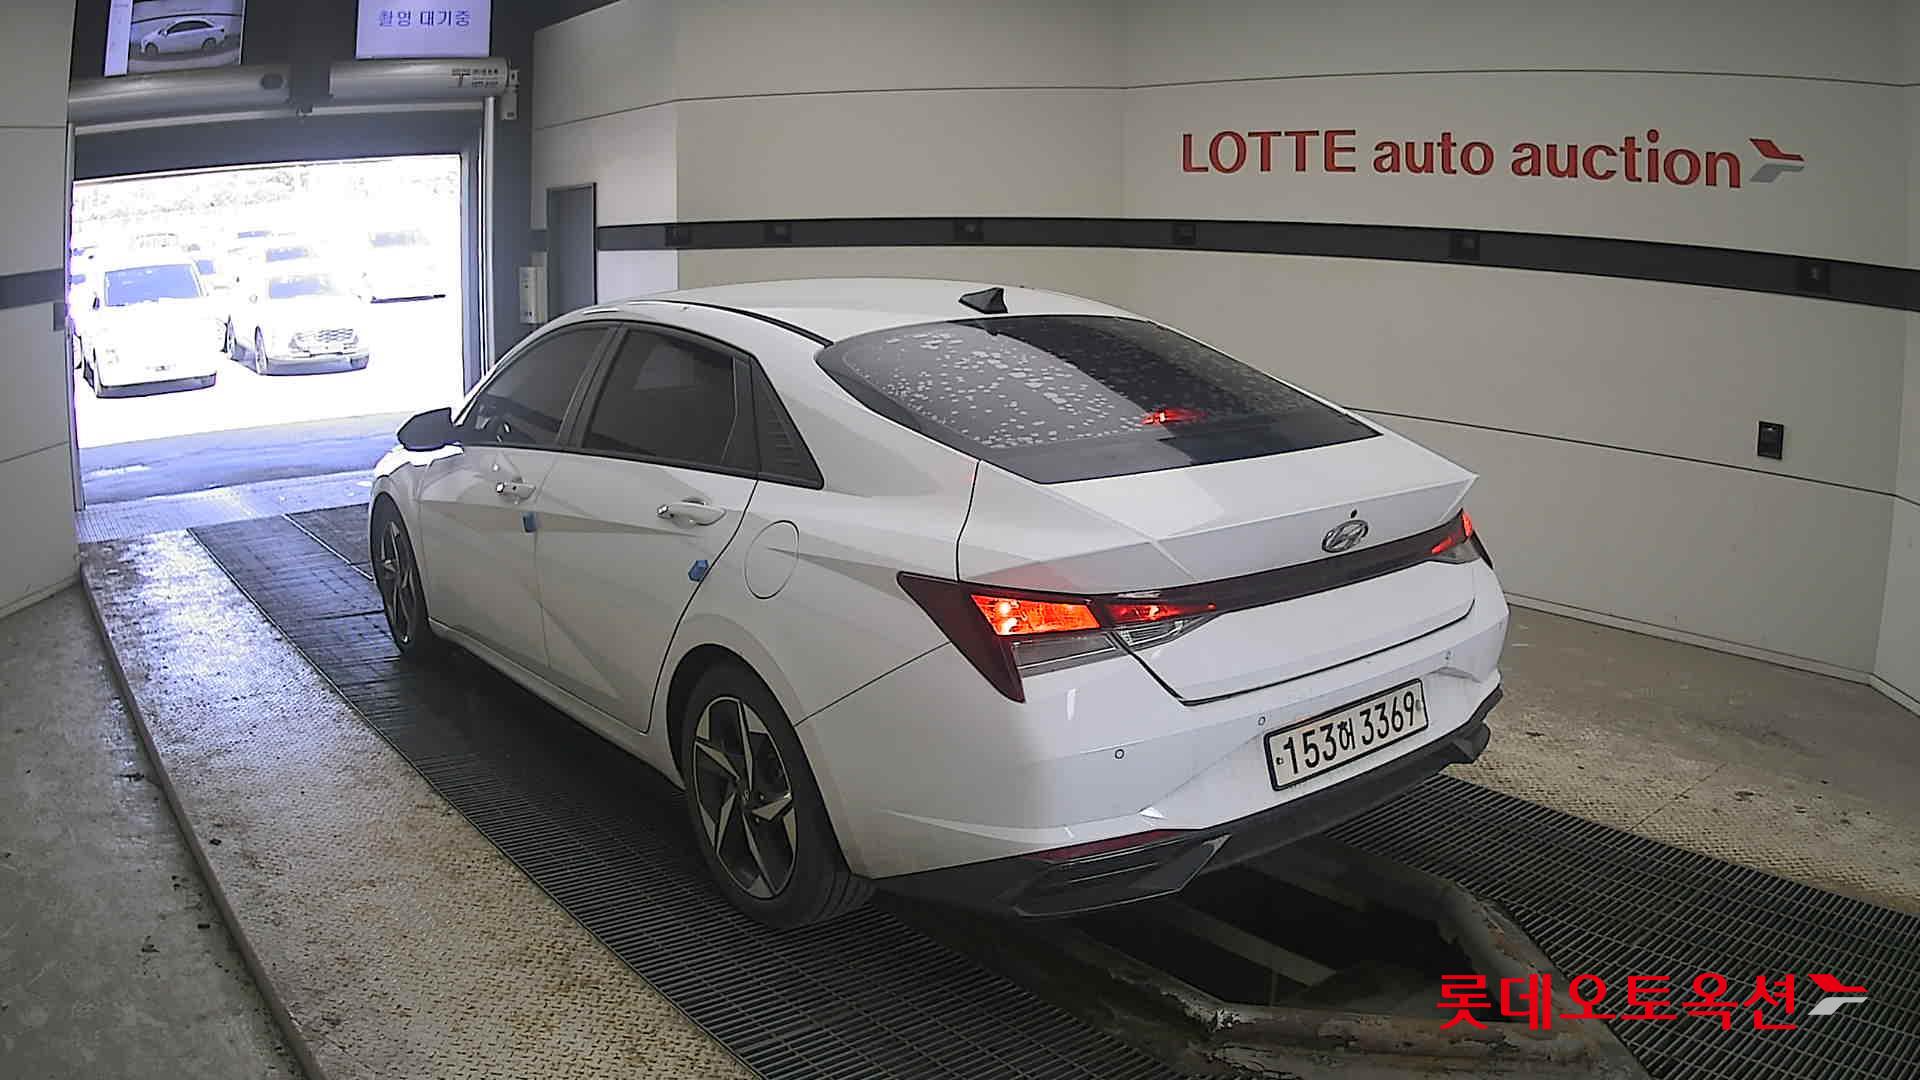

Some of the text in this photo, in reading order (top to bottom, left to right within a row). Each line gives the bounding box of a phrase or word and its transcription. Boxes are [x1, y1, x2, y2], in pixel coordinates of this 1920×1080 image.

[420, 10, 471, 28] 대기중
[1183, 129, 1741, 188] LOTTE auto auction
